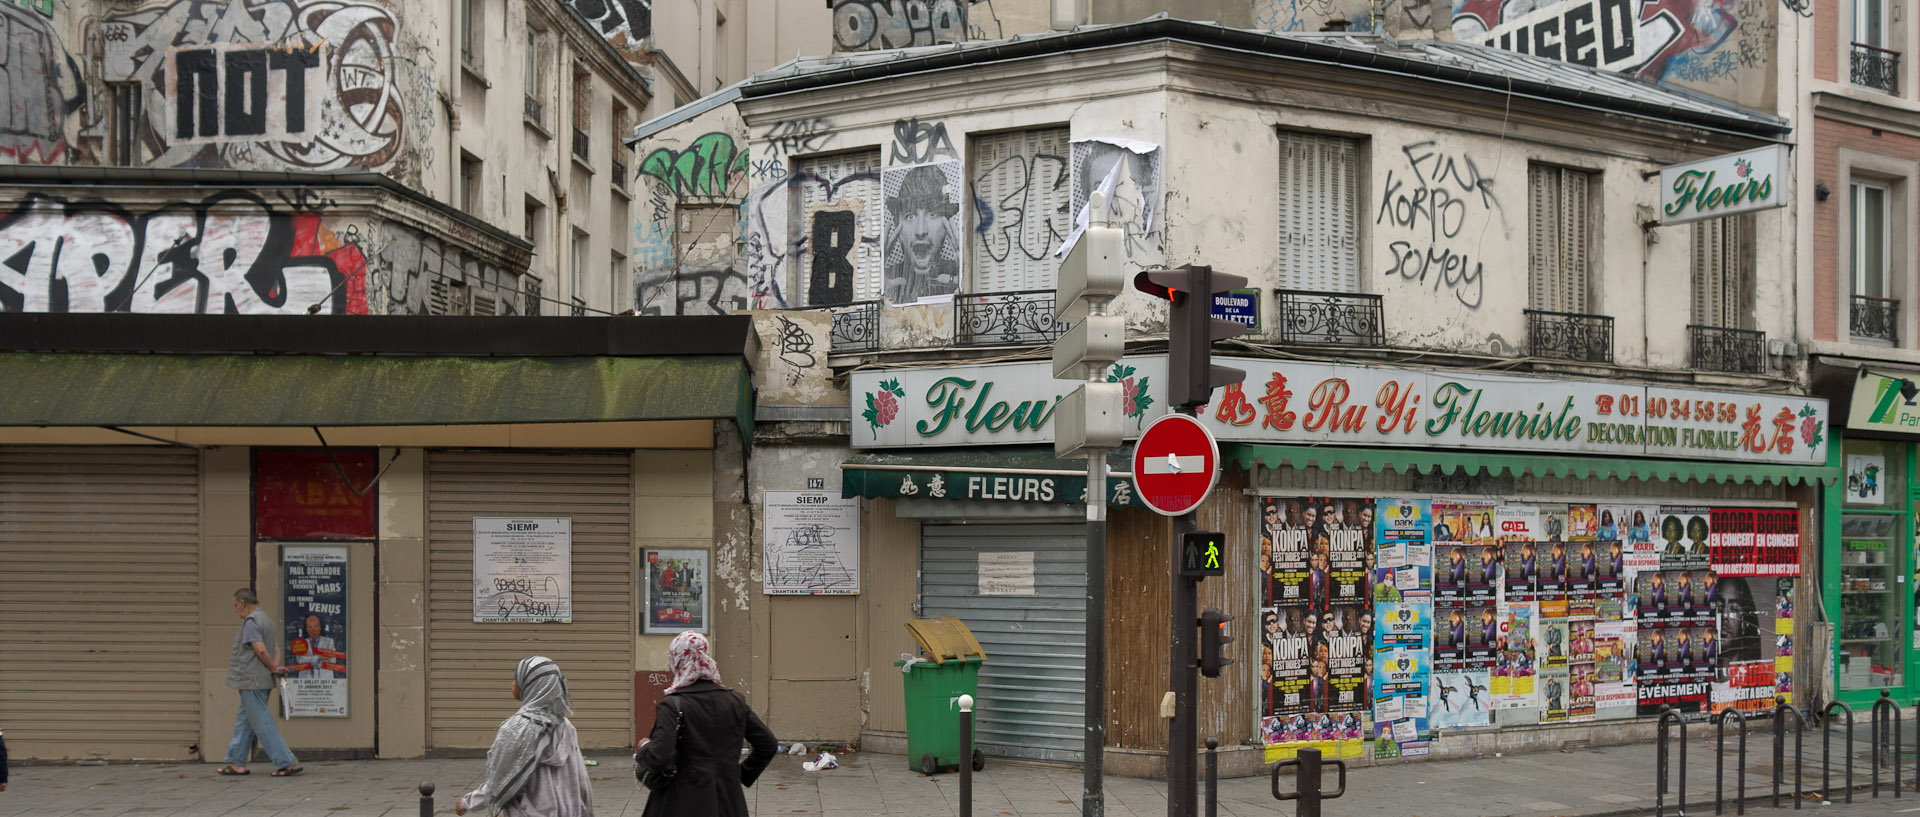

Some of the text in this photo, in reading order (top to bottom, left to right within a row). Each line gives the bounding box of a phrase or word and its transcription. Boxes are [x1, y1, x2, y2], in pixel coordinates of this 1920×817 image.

[1664, 168, 1772, 216] Fleurs
[1215, 296, 1250, 307] BOULEVARD
[915, 375, 1063, 438] Fleu
[1216, 371, 1297, 433] 如意
[1303, 377, 1582, 442] Ru Yi Fleuriste
[1619, 394, 1738, 423] 01 40 34 58 58
[1587, 421, 1740, 450] DECORATION FLORALE
[1738, 403, 1796, 454] 花店
[899, 473, 947, 499] 如意
[968, 473, 1056, 502] FLEURS
[796, 496, 828, 504] SIEMP
[506, 523, 539, 531] SIEMP
[1712, 512, 1754, 533] BOOBA
[1757, 512, 1799, 534] BOOBA
[1272, 530, 1308, 552] KONPA
[1330, 530, 1364, 552] KONPA
[1711, 533, 1755, 547] EN CONCERT
[1756, 534, 1799, 547] EN CONCERT
[289, 566, 341, 575] PAUL DEWANDRE
[1731, 564, 1742, 574] OCT
[1743, 564, 1755, 574] 2011
[1756, 564, 1800, 574] SAM 01 OCT 2011
[316, 582, 341, 594] MARS
[309, 602, 341, 614] VENUS
[1273, 638, 1309, 660] KONPA
[1329, 636, 1364, 659] KONPA
[1638, 682, 1709, 699] ÉVÉNEMENT
[1639, 696, 1665, 706] WATCH
[1681, 693, 1708, 702] THRONE
[1755, 686, 1776, 699] BERCY
